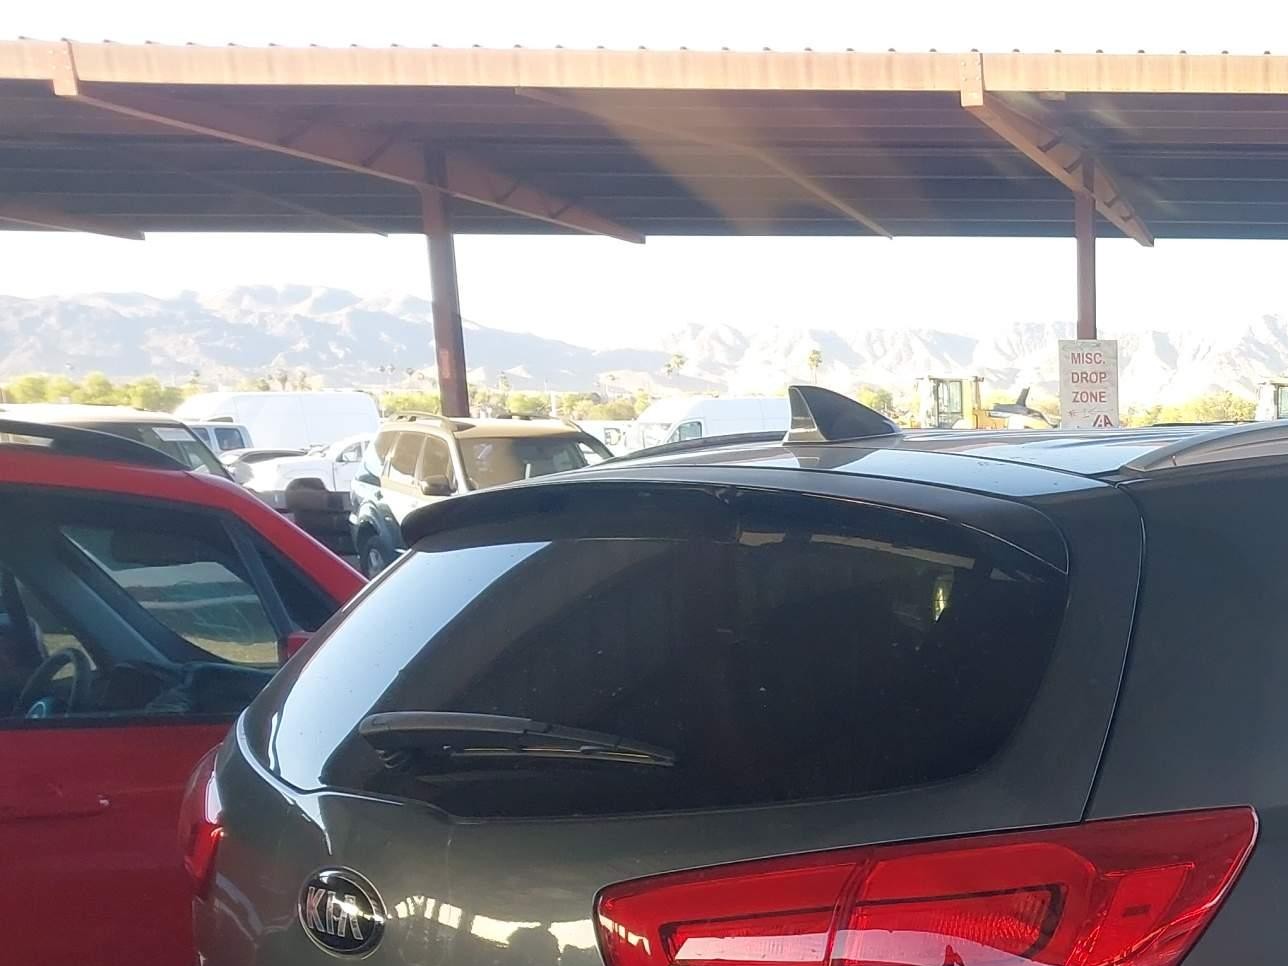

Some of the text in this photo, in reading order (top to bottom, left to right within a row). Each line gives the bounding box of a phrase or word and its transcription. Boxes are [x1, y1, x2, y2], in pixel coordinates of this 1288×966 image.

[1071, 352, 1106, 365] MISC.
[1071, 371, 1107, 384] DROP
[1071, 391, 1107, 403] ZONE
[306, 886, 364, 940] KIA
